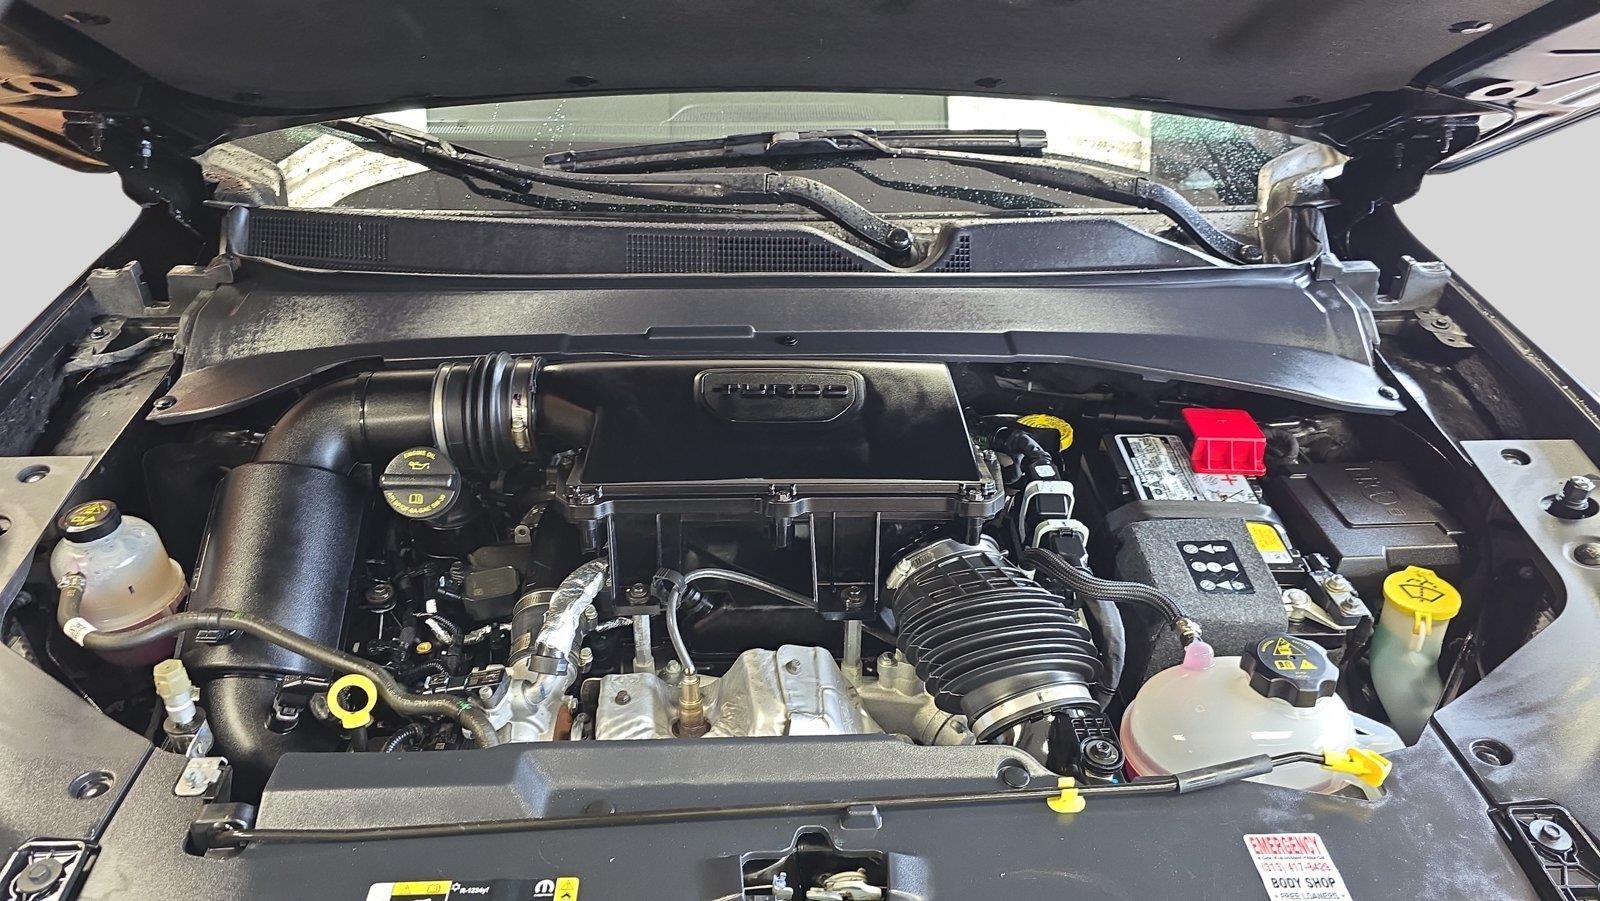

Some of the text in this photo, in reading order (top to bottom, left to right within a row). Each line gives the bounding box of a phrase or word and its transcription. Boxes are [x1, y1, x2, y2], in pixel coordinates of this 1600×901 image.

[403, 449, 436, 460] ENGINE OIL
[1249, 836, 1321, 854] EMERGENCY
[1270, 877, 1336, 889] BODY SHOP
